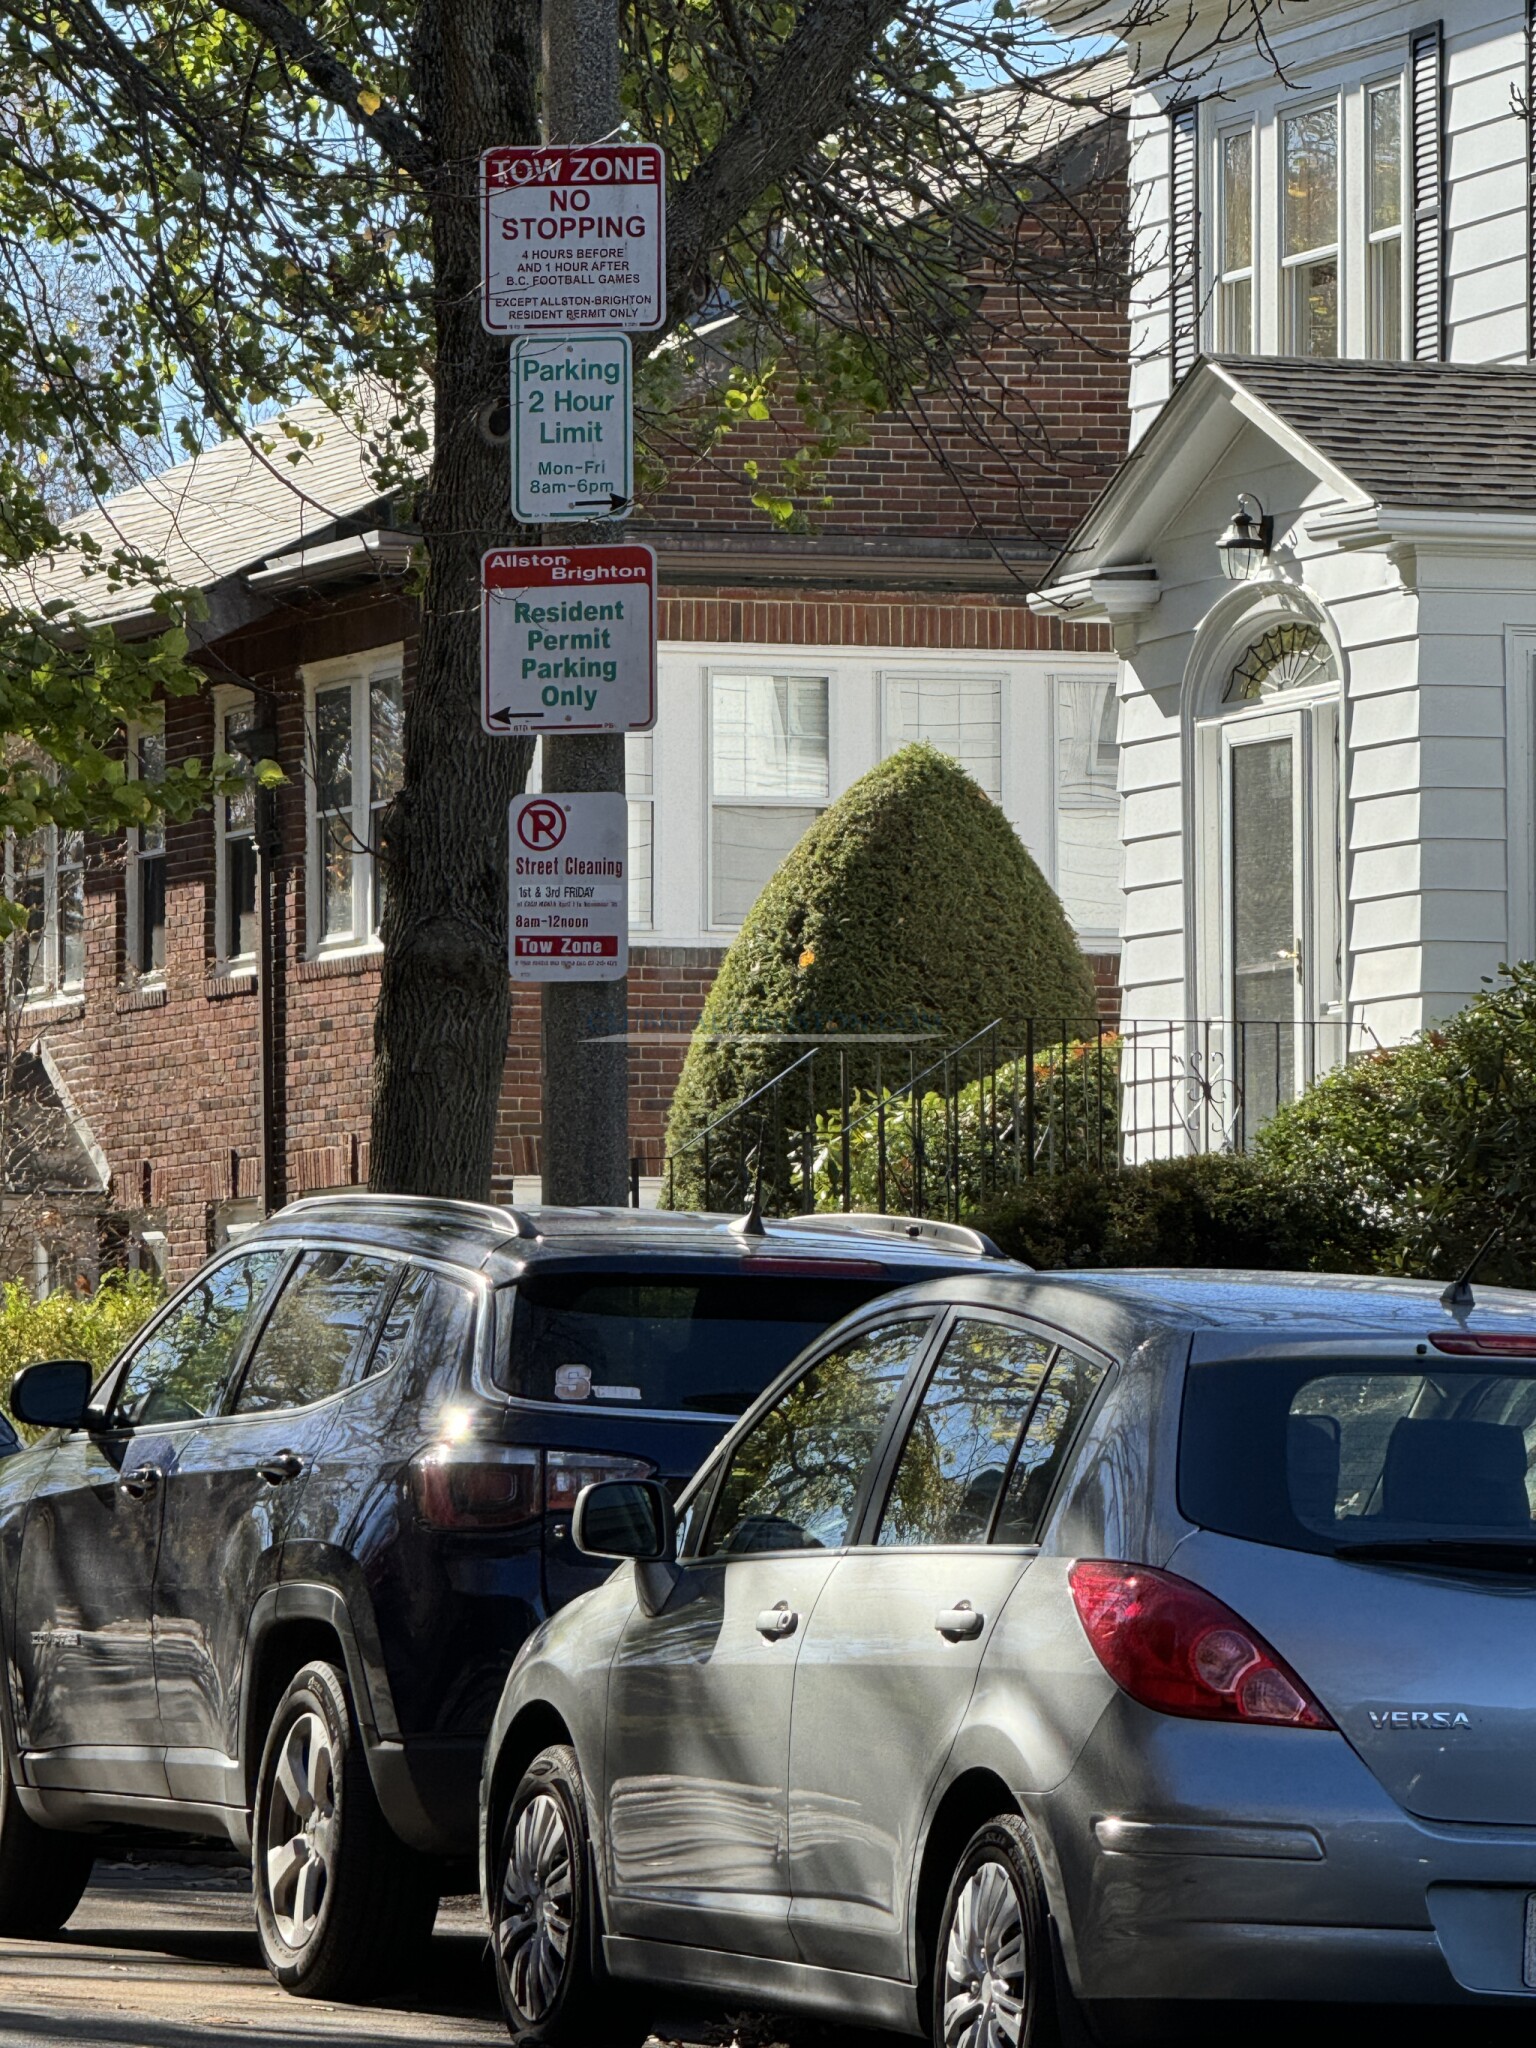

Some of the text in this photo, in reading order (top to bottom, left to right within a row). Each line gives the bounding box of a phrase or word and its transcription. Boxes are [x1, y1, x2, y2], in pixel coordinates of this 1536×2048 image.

[492, 156, 656, 183] TOW ZONE
[549, 189, 591, 212] NO
[501, 215, 646, 240] STOPPING
[521, 248, 624, 259] 4 HOURS BEFORE
[517, 260, 629, 272] AND 1 HOUR AFTER
[506, 273, 640, 286] B.C. FOOTBALL GAMES
[496, 295, 652, 307] EXCEPT ALLSTON-BRIGHTON
[508, 307, 638, 320] RESIDENT PERMIT ONLY
[523, 358, 620, 385] Parking
[528, 390, 615, 413] 2 Hour
[540, 421, 603, 444] Limit
[538, 460, 606, 475] Mon-Fri
[530, 478, 614, 495] 8am-6pm
[490, 555, 567, 568] Allston
[551, 566, 646, 581] Brighton
[514, 600, 624, 624] Resident
[527, 627, 611, 651] Permit
[521, 656, 617, 682] Parking
[541, 684, 598, 711] Only
[516, 856, 623, 878] Street Cleaning
[518, 886, 595, 898] 1st & 3rd FRIDAY
[516, 915, 589, 928] 8am-12noon
[519, 938, 602, 954] Tow Zone
[1368, 1711, 1472, 1730] VERSA
